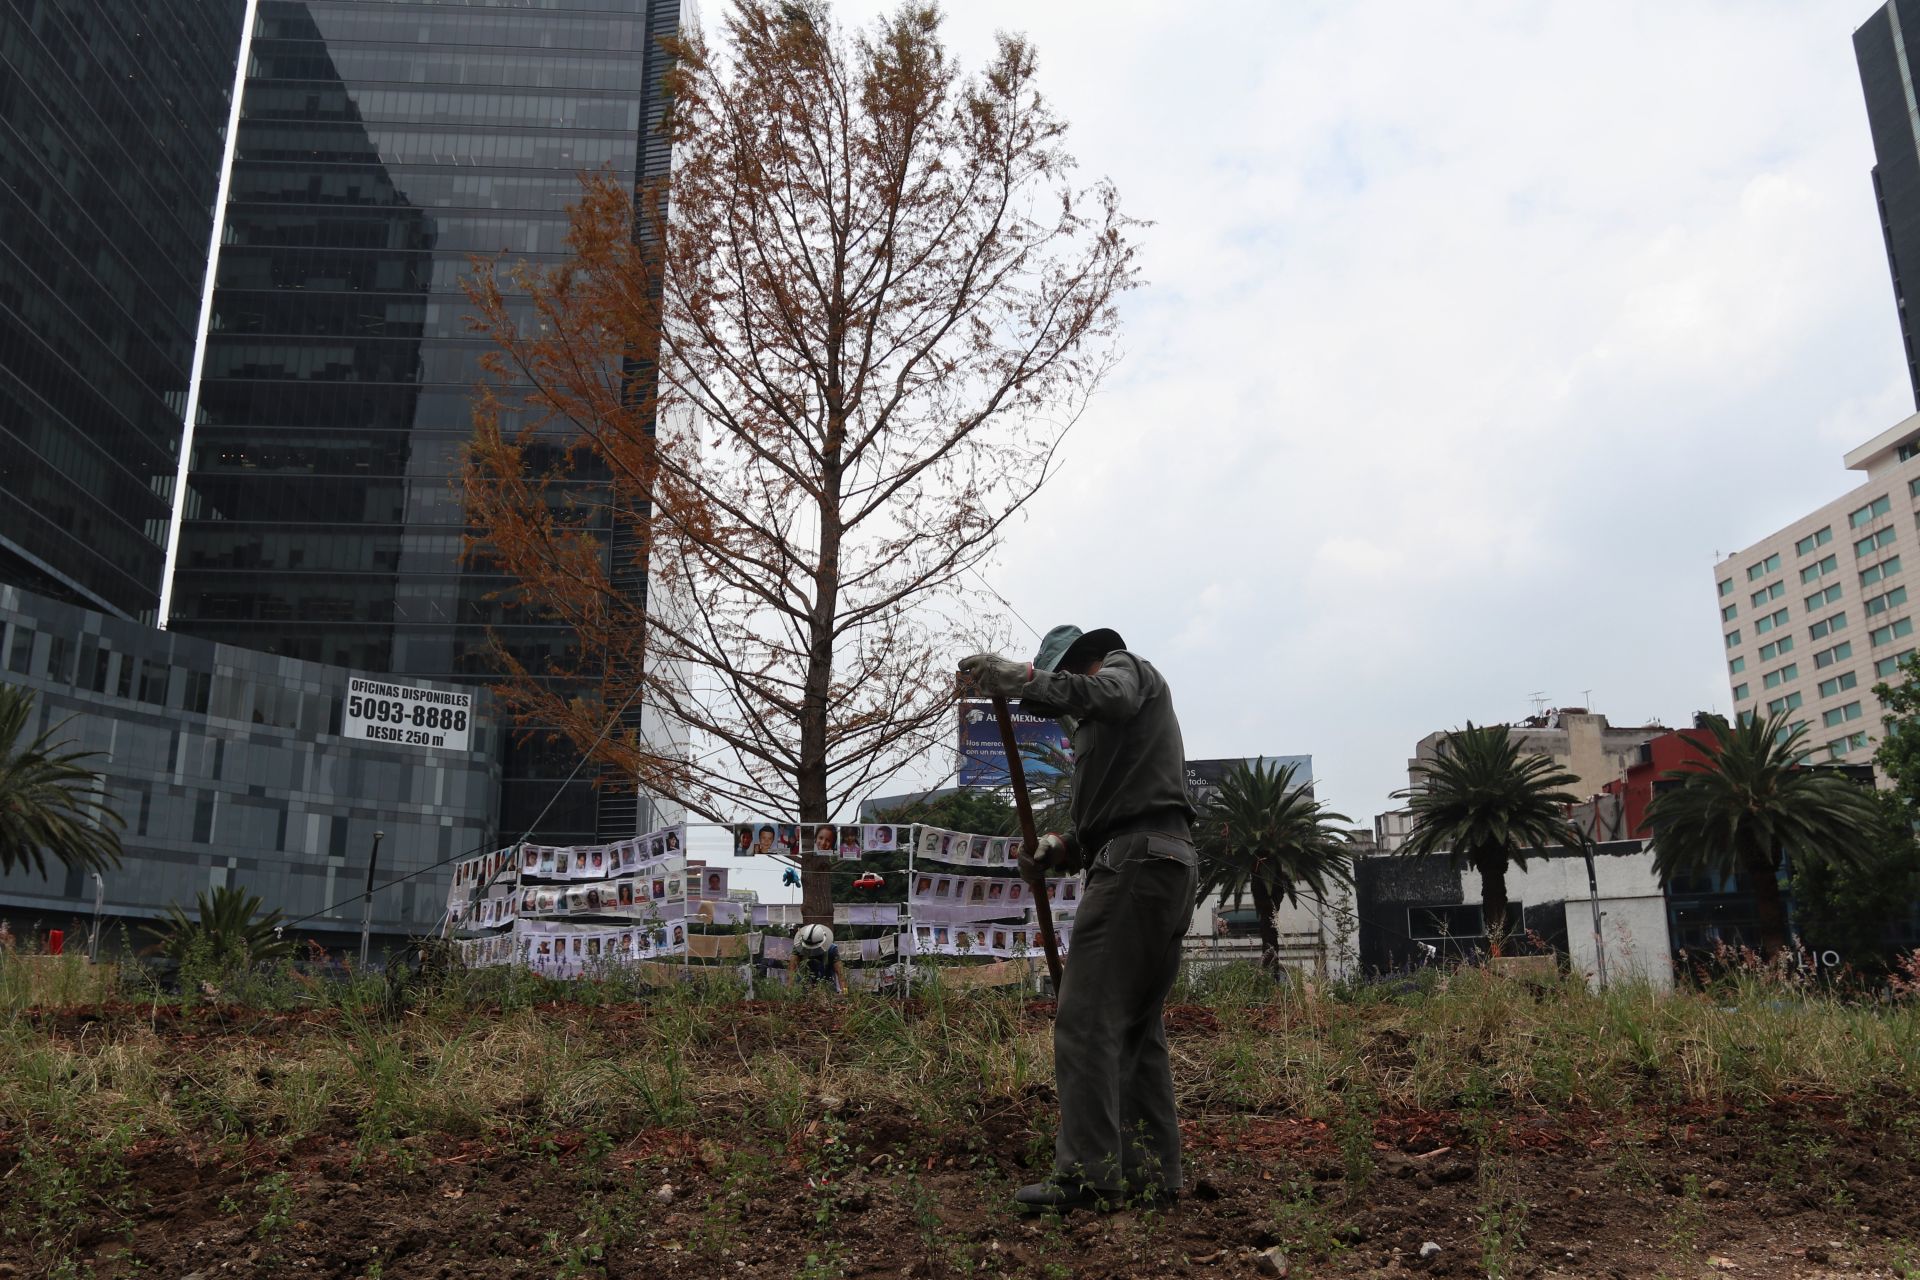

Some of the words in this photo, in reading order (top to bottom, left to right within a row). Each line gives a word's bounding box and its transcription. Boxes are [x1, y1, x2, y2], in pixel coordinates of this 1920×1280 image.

[351, 679, 400, 698] OFICINAS
[401, 688, 469, 707] DISPONIBLES
[348, 695, 467, 731] 5093-8888
[986, 713, 1046, 723] AEMEXICO
[366, 724, 403, 742] DESDE
[406, 730, 430, 745] 250
[1189, 778, 1209, 786] todo.
